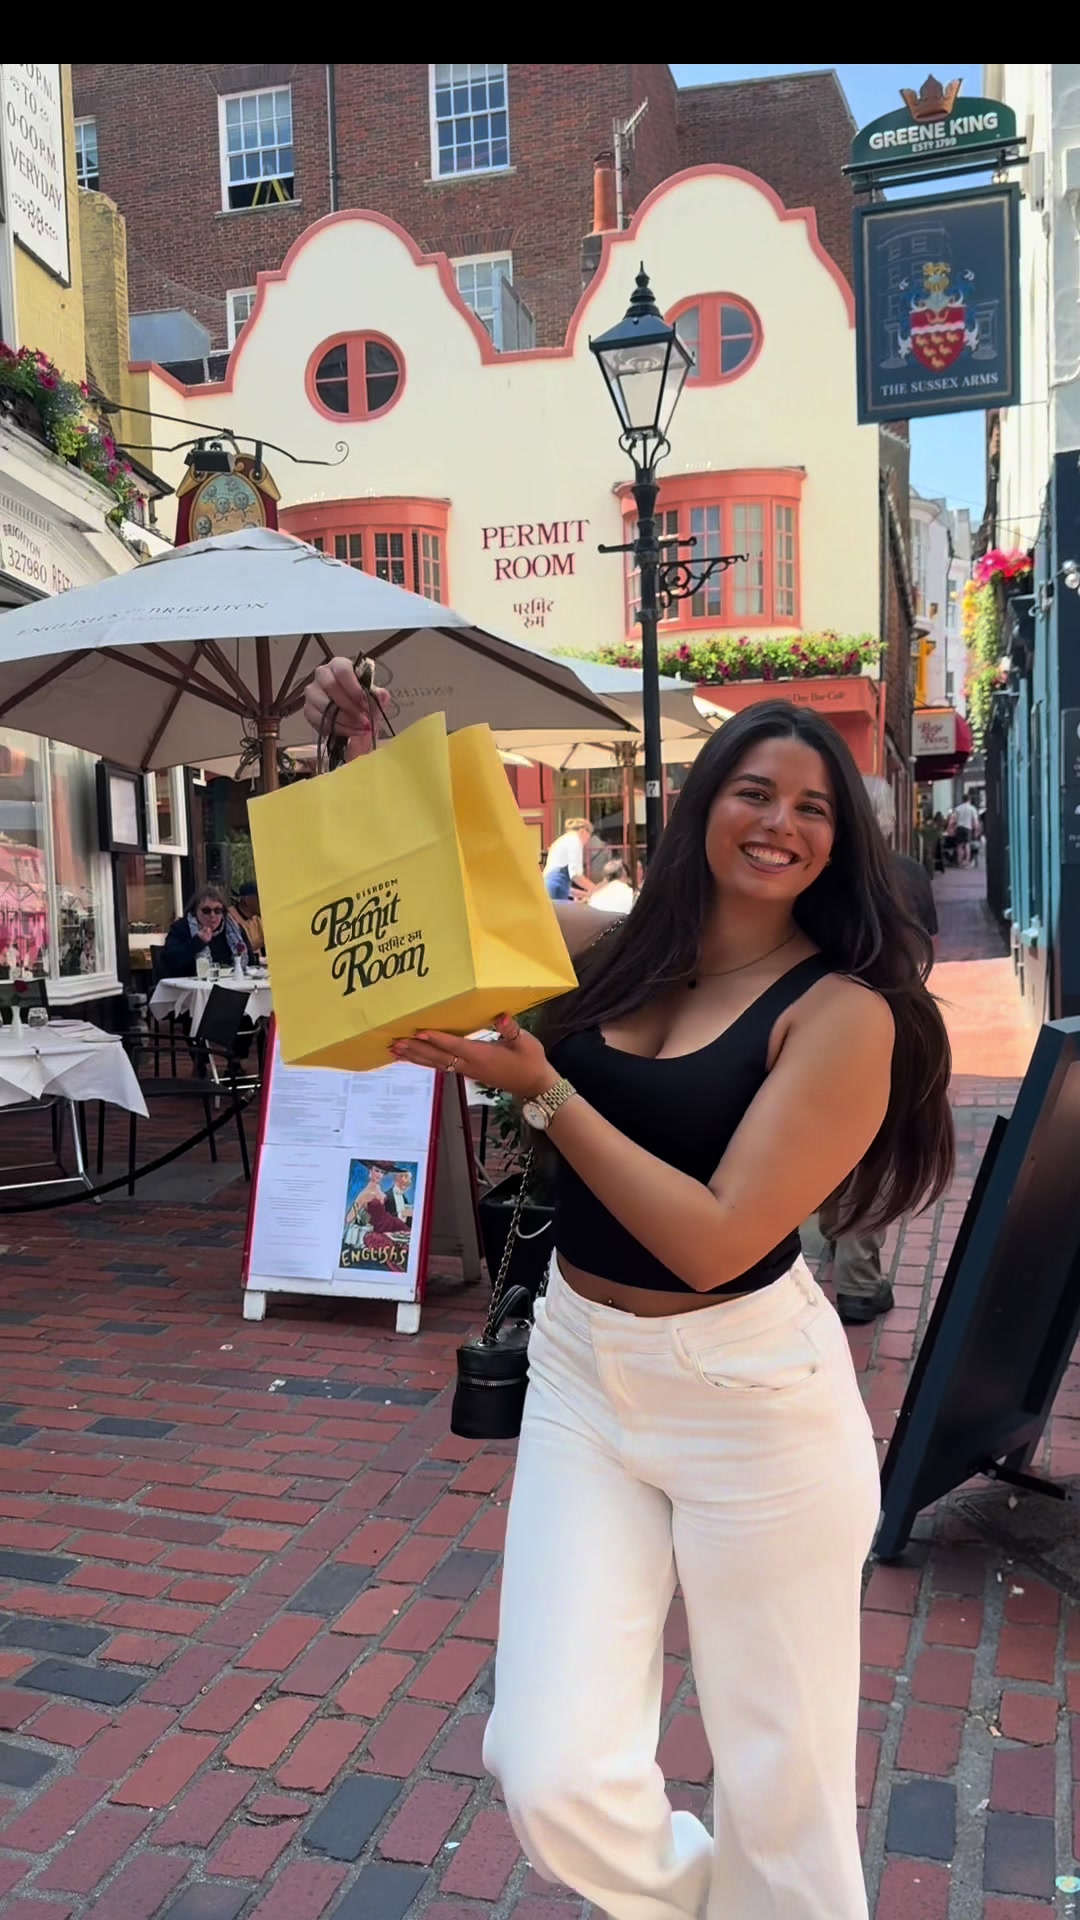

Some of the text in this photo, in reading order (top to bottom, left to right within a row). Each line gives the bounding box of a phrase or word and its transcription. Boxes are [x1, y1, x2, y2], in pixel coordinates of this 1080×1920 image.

[21, 82, 37, 115] TO
[869, 112, 998, 150] GREENE KING
[935, 137, 957, 149] 1799
[880, 372, 999, 396] THE SUSSEX ARMS
[2, 523, 41, 559] BRIGHTON
[481, 519, 590, 550] PERMIT
[8, 546, 47, 584] 327980
[494, 552, 575, 581] ROOM
[356, 878, 398, 900] DISHOOM
[311, 890, 401, 952] Permit
[332, 940, 429, 997] Room
